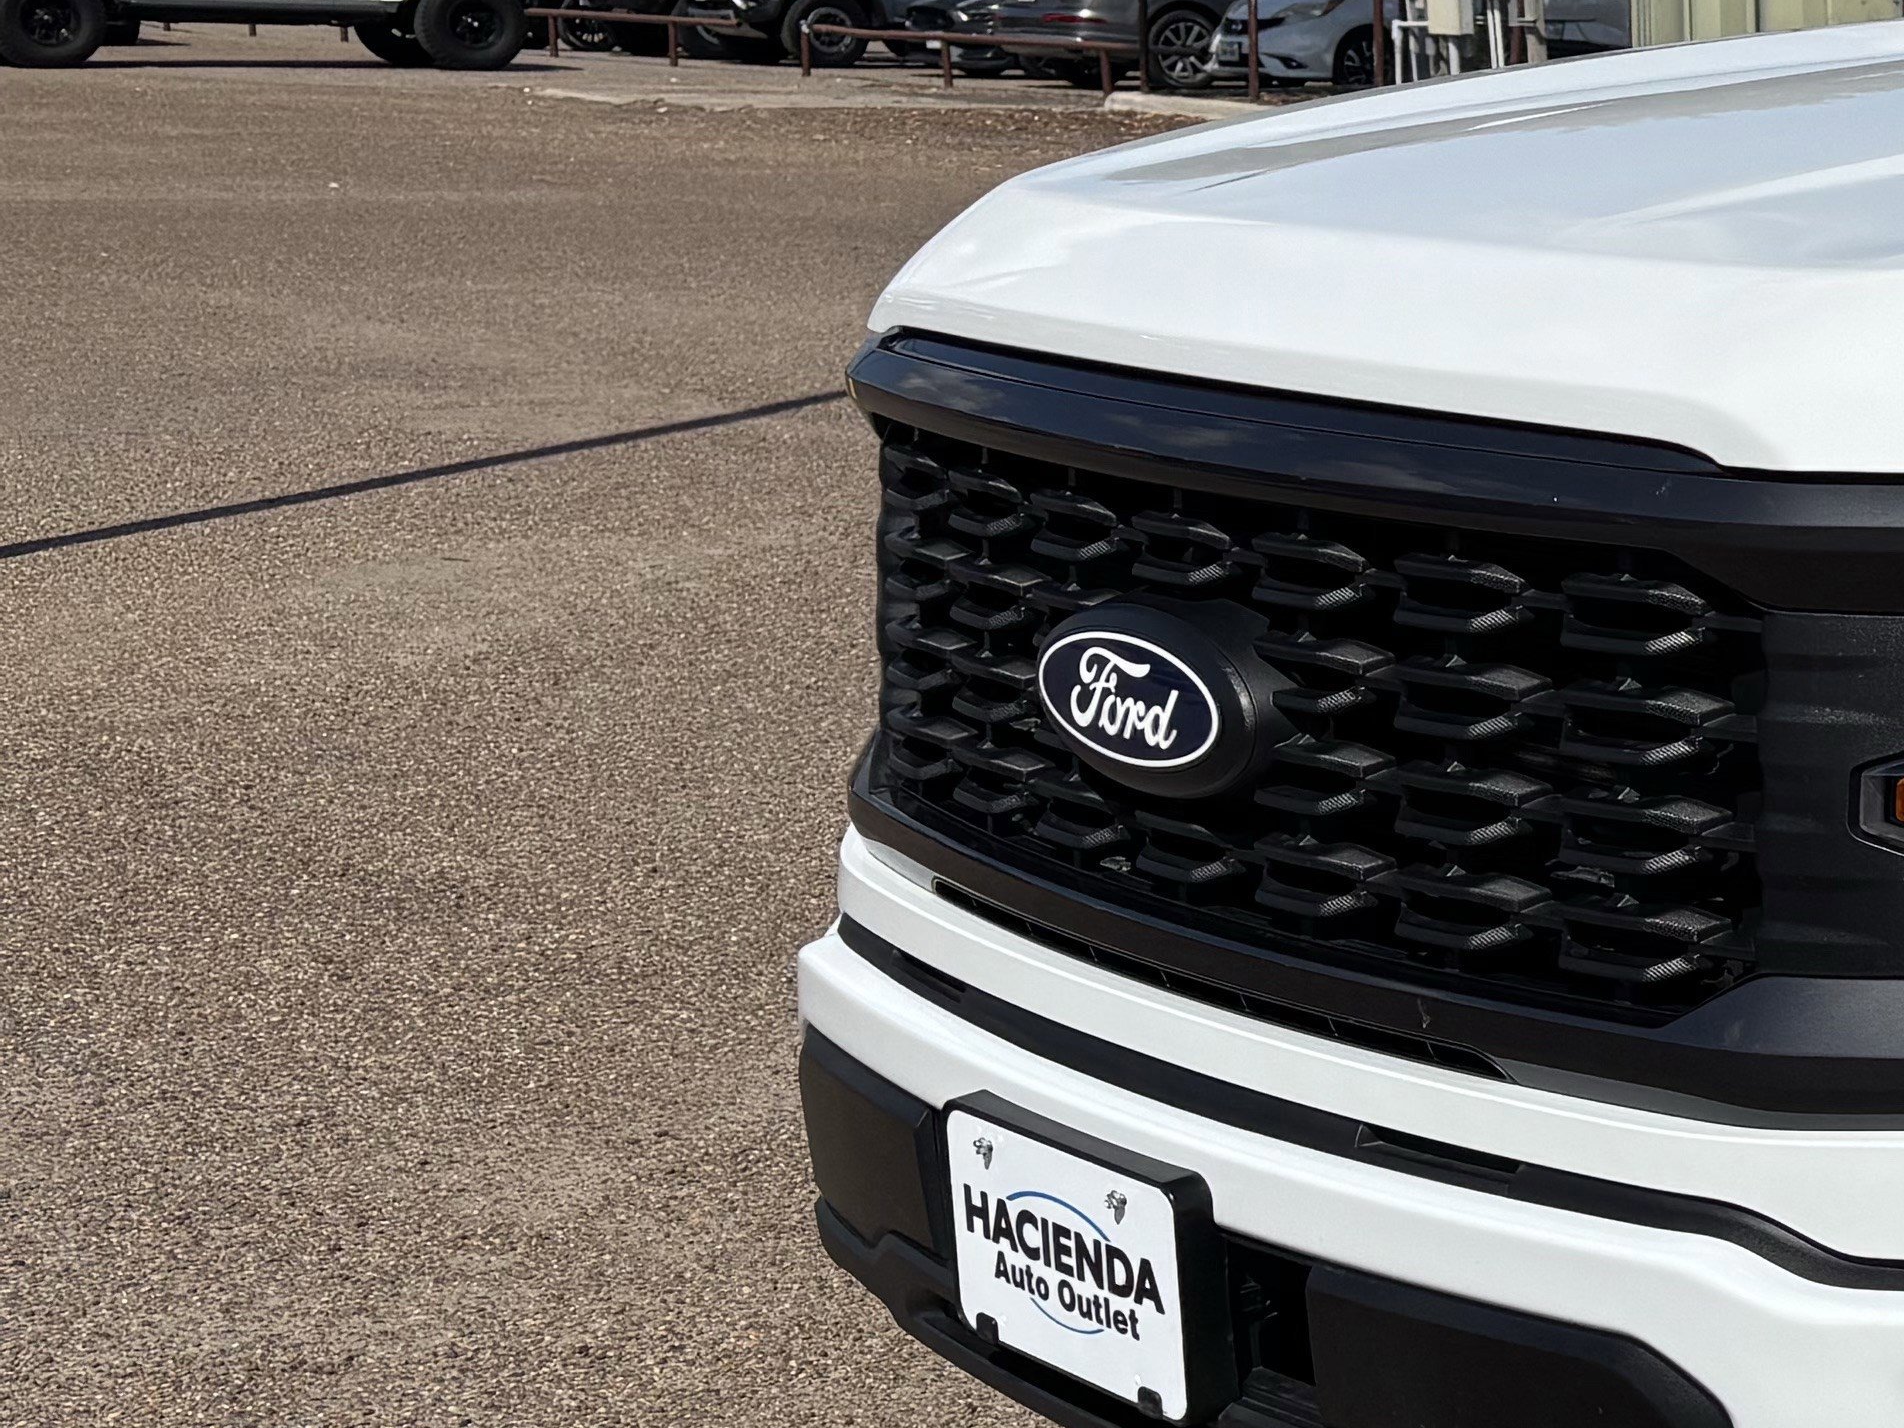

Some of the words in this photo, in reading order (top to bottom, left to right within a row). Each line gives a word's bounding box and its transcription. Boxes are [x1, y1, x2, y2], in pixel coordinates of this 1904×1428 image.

[1070, 646, 1179, 750] Ford
[963, 1183, 1166, 1315] HACIENDA
[994, 1251, 1050, 1301] Auto
[1057, 1279, 1140, 1341] Outlet
